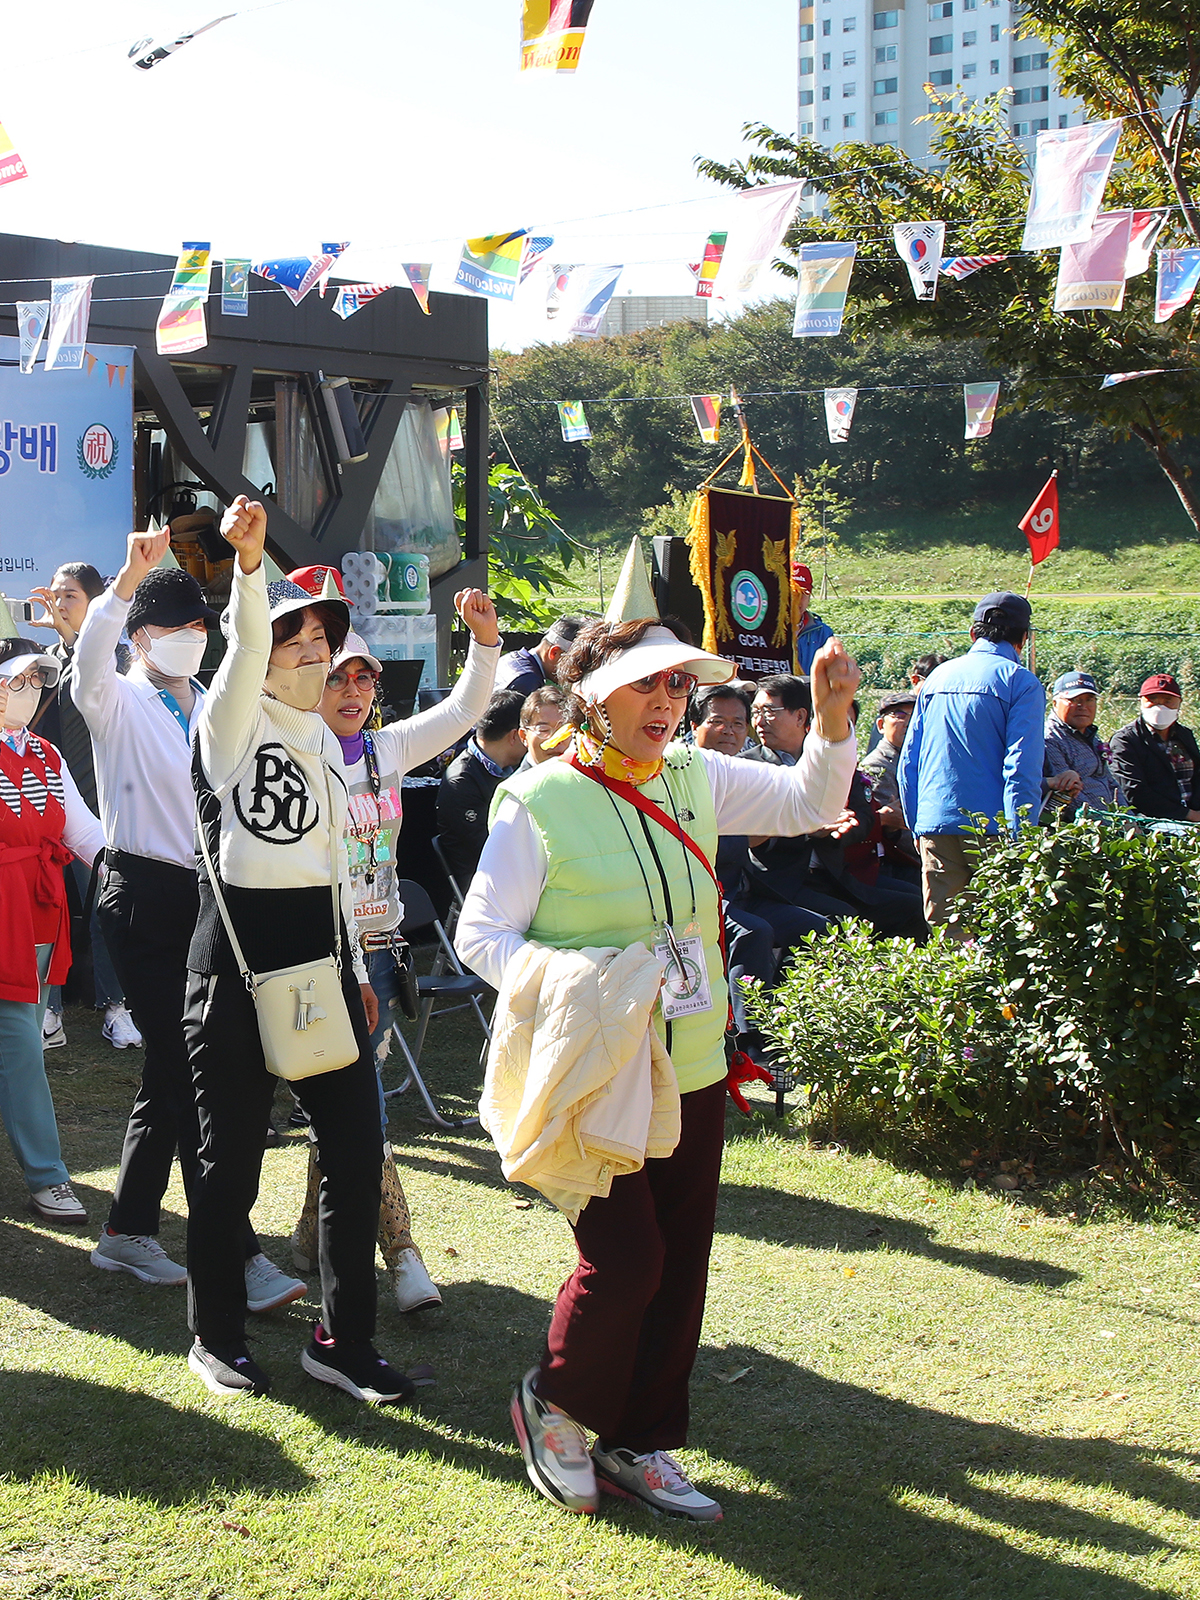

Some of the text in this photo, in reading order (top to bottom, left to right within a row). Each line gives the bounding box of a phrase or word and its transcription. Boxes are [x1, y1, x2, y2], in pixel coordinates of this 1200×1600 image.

[85, 431, 110, 464] 祝
[738, 633, 768, 648] GCPA
[719, 653, 792, 675] 구파크골프협회
[354, 903, 388, 917] nking
